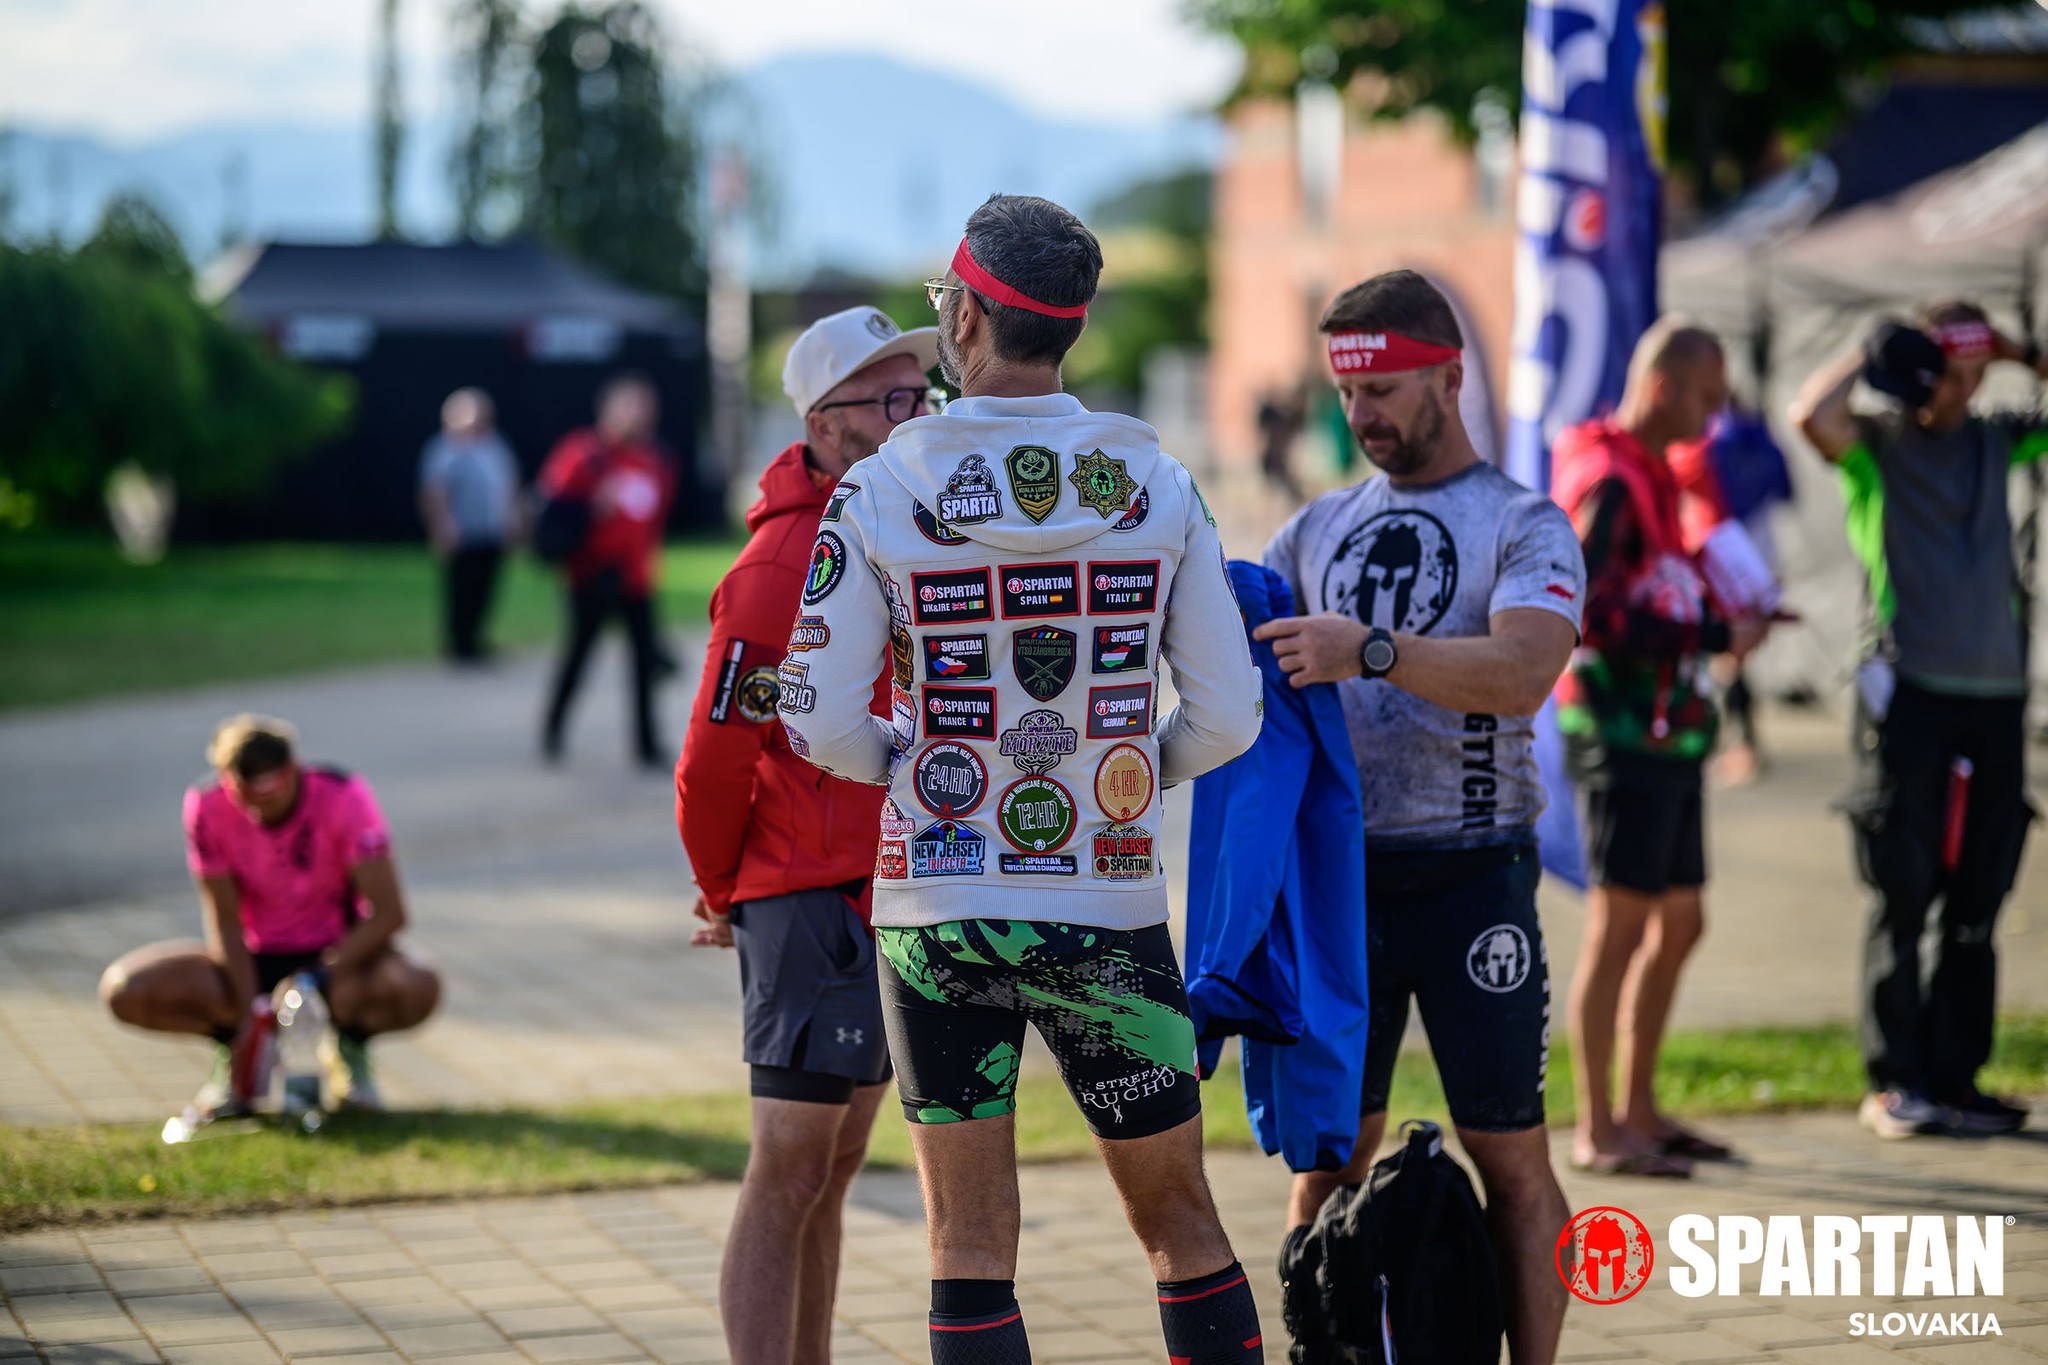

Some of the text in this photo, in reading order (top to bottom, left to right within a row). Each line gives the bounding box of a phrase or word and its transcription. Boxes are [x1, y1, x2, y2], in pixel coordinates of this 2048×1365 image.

[960, 484, 986, 492] SPARTAN
[942, 496, 997, 520] SPARTA
[823, 534, 841, 556] TRIFECTA
[1024, 576, 1072, 591] SPARTAN
[1110, 574, 1153, 588] SPARTAN
[937, 584, 984, 598] SPARTAN
[1106, 593, 1130, 603] ITALY
[1020, 595, 1048, 605] SPAIN
[923, 603, 950, 612] UK&IRE
[1111, 629, 1145, 643] SPARTAN
[941, 640, 982, 652] SPARTAN
[1057, 648, 1071, 656] 2024
[945, 701, 990, 714] SPARTAN
[1110, 698, 1145, 712] SPARTAN
[938, 717, 967, 726] FRANCE
[1103, 717, 1127, 727] GERMANY
[1004, 736, 1074, 753] MORZINE
[918, 745, 983, 779] SPARTAN HURRICANE HEAT FINISHER
[1110, 770, 1139, 797] 4 HR
[1002, 780, 1070, 814] SPARTAN HURRICANE HEAT FINISHER
[915, 842, 938, 859] NEW
[939, 842, 982, 858] JERSEY
[1094, 838, 1153, 859] NEW JERSEY
[927, 858, 966, 870] TRIFECTA
[1026, 857, 1061, 865] SPARTAN
[1110, 858, 1150, 871] SPARTAN
[1096, 1068, 1159, 1090] STREFA
[1081, 1066, 1176, 1109] RUCHU
